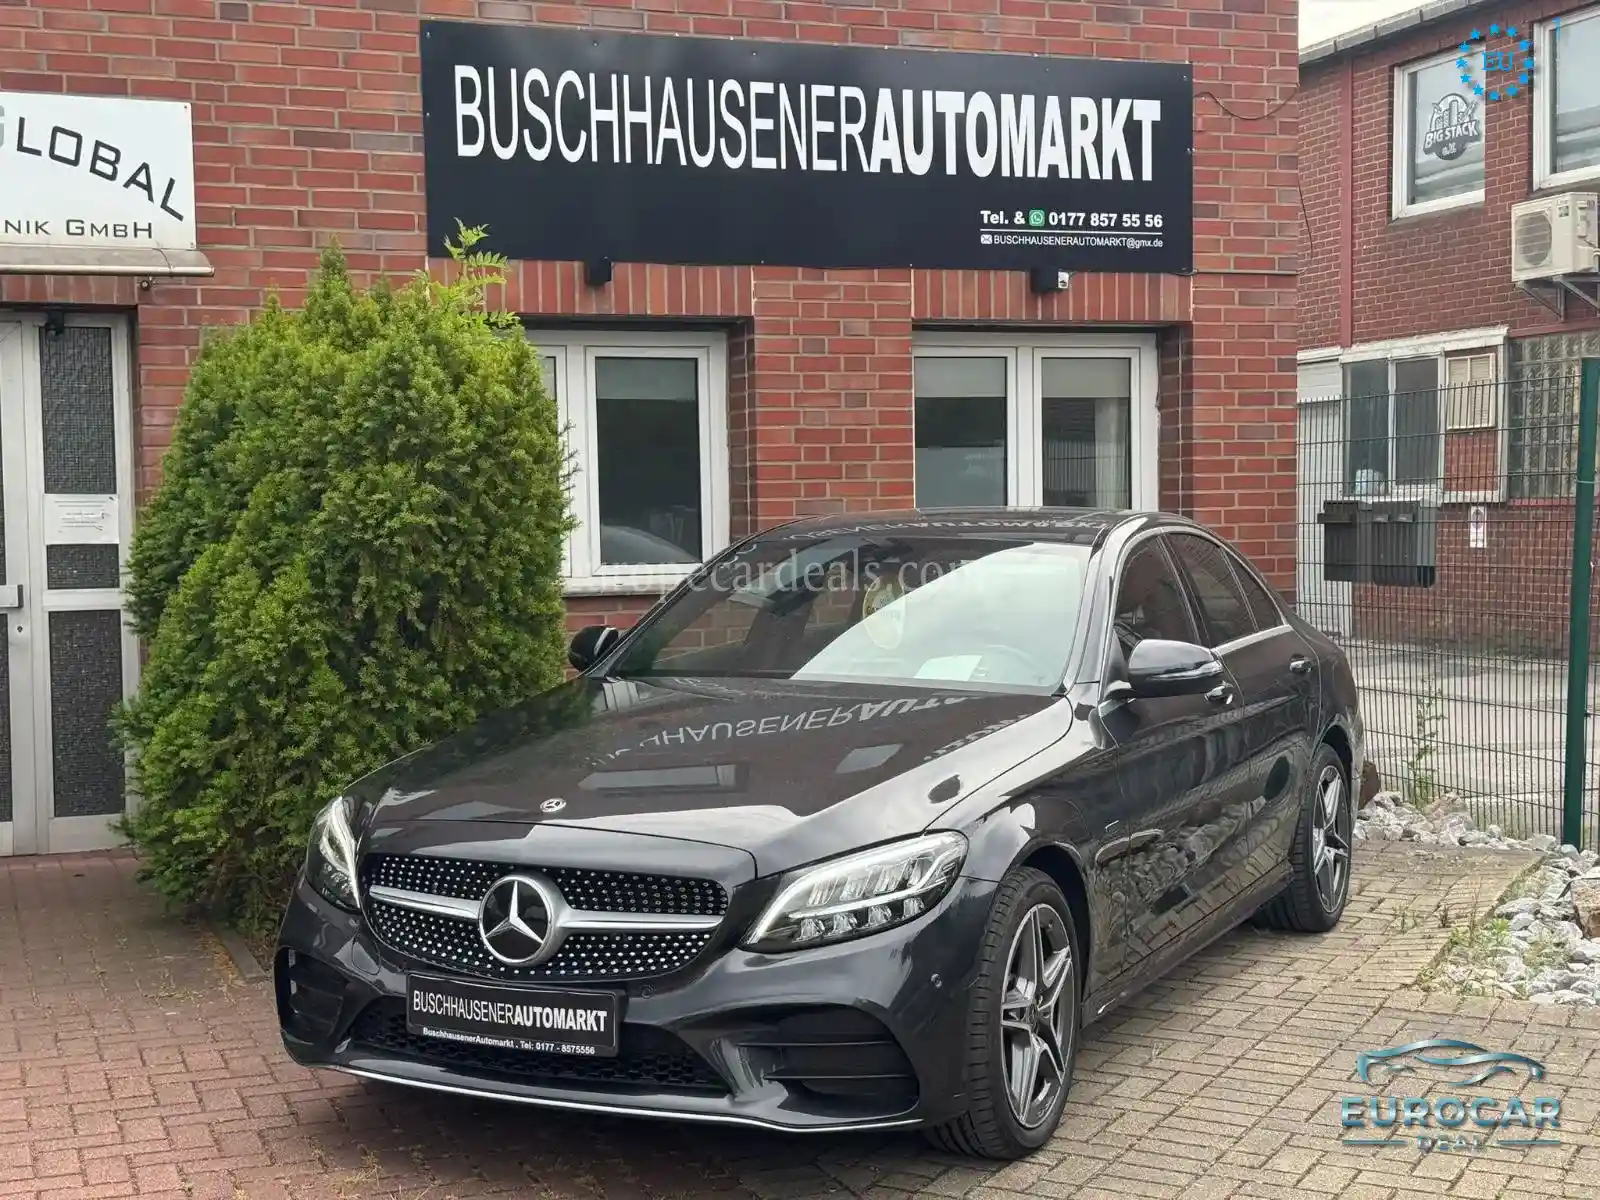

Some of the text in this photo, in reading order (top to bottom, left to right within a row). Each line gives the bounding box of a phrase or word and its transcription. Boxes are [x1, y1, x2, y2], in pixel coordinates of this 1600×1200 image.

[454, 64, 1162, 182] BUSCHHAUSENERAUTOMARKT
[1424, 130, 1445, 149] BIG
[1444, 119, 1479, 141] STACK
[0, 103, 184, 222] LOBAL
[980, 210, 1163, 228] Tel. & 0177 857 55 56
[993, 234, 1164, 249] BUSCHHAUSENERAUTOMARKT@gmx.de
[413, 989, 608, 1032] BUSCHHAUSENERAUTOMARKT
[422, 1026, 515, 1049] BuschhausenerAutomarkt
[535, 1042, 555, 1052] 0177
[561, 1044, 596, 1055] 8575556
